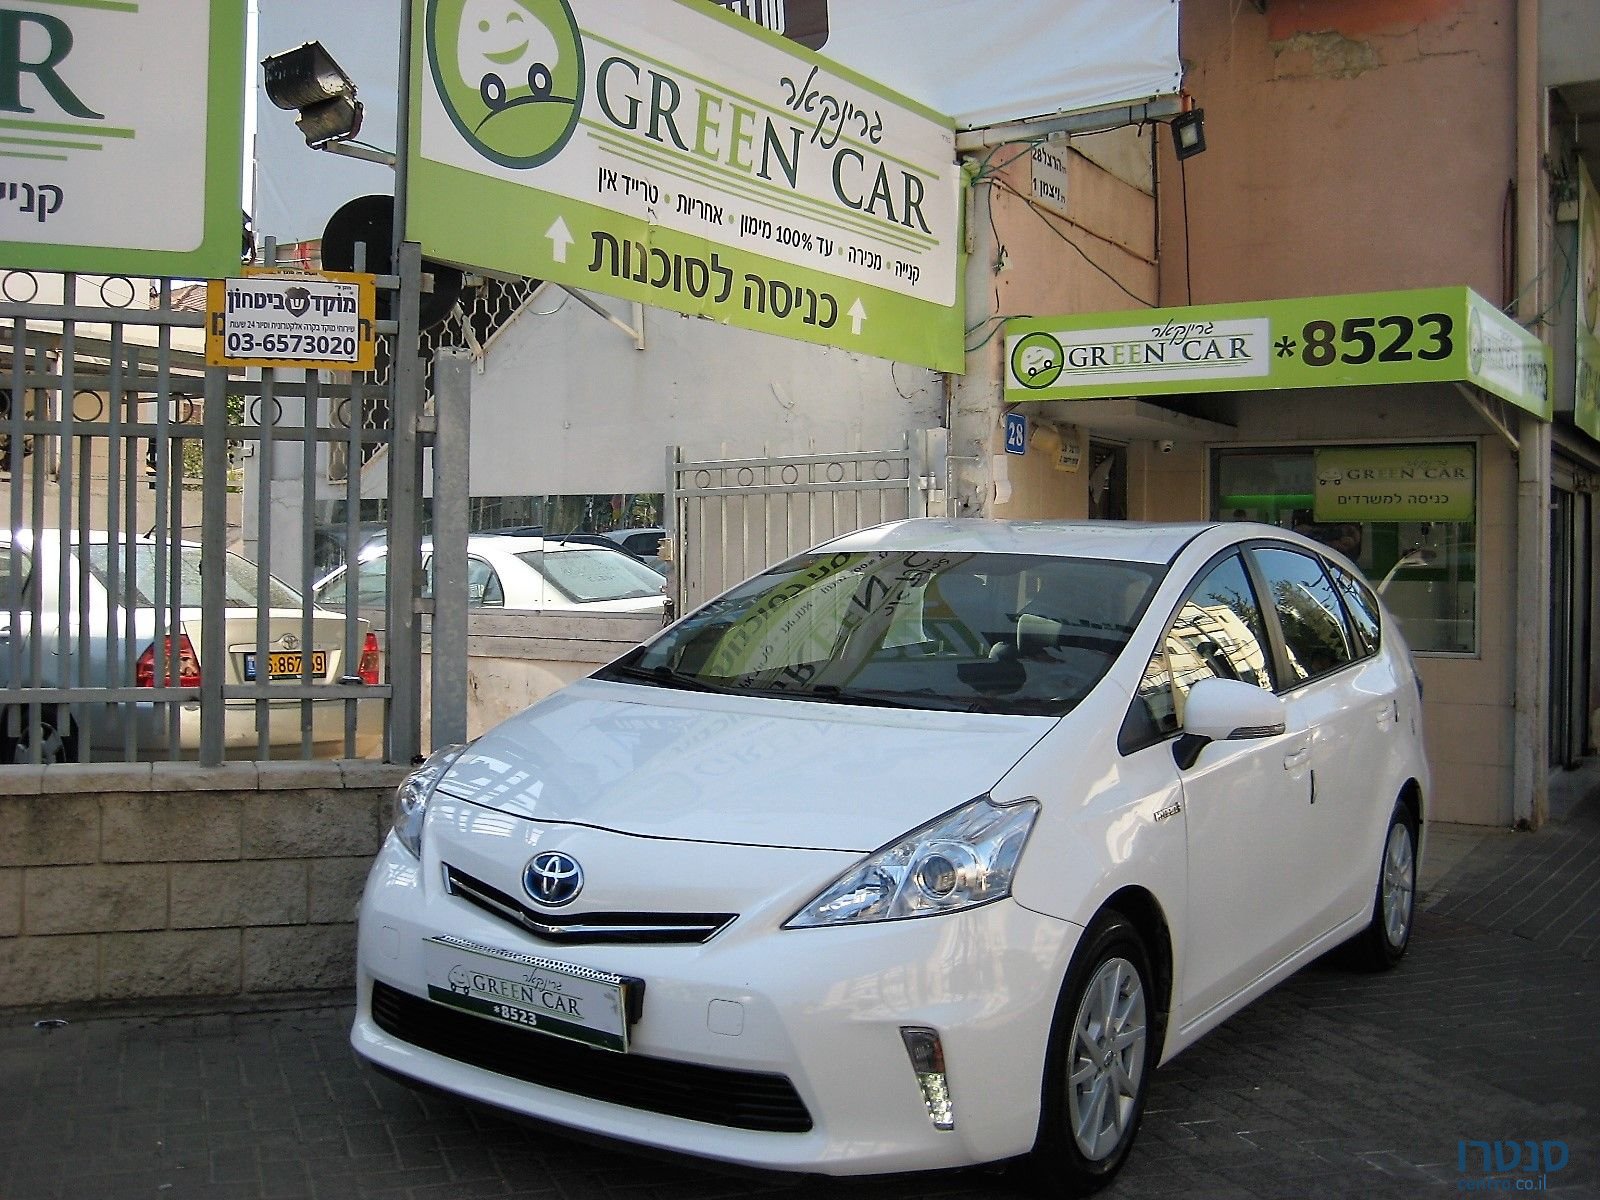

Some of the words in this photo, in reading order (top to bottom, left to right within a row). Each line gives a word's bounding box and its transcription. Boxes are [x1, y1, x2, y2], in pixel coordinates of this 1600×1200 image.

[780, 65, 883, 149] גרינקאר
[596, 56, 804, 189] GREEN
[832, 148, 932, 234] CAR
[598, 167, 617, 192] אין
[621, 174, 659, 204] טרייד
[676, 193, 723, 226] אחריות
[740, 214, 772, 239] מימון
[776, 225, 812, 251] 100%
[816, 236, 834, 257] עד
[848, 246, 882, 270] מכירה
[588, 230, 734, 303] לסוכנות
[895, 260, 920, 286] קנייה
[227, 289, 285, 314] ביטחון
[311, 293, 356, 316] מוקד
[744, 274, 839, 330] כניסה
[228, 332, 356, 356] 03-6573020
[1152, 318, 1214, 346] גרינקאר
[1068, 342, 1165, 368] GREEN
[1182, 337, 1252, 361] CAR
[1008, 422, 1023, 447] 28
[1347, 468, 1415, 480] GREEN
[1424, 466, 1466, 480] CAR
[1338, 493, 1402, 505] למשרדים
[1408, 494, 1449, 504] כניסה
[473, 974, 534, 1003] GREEN
[542, 990, 581, 1016] CAR
